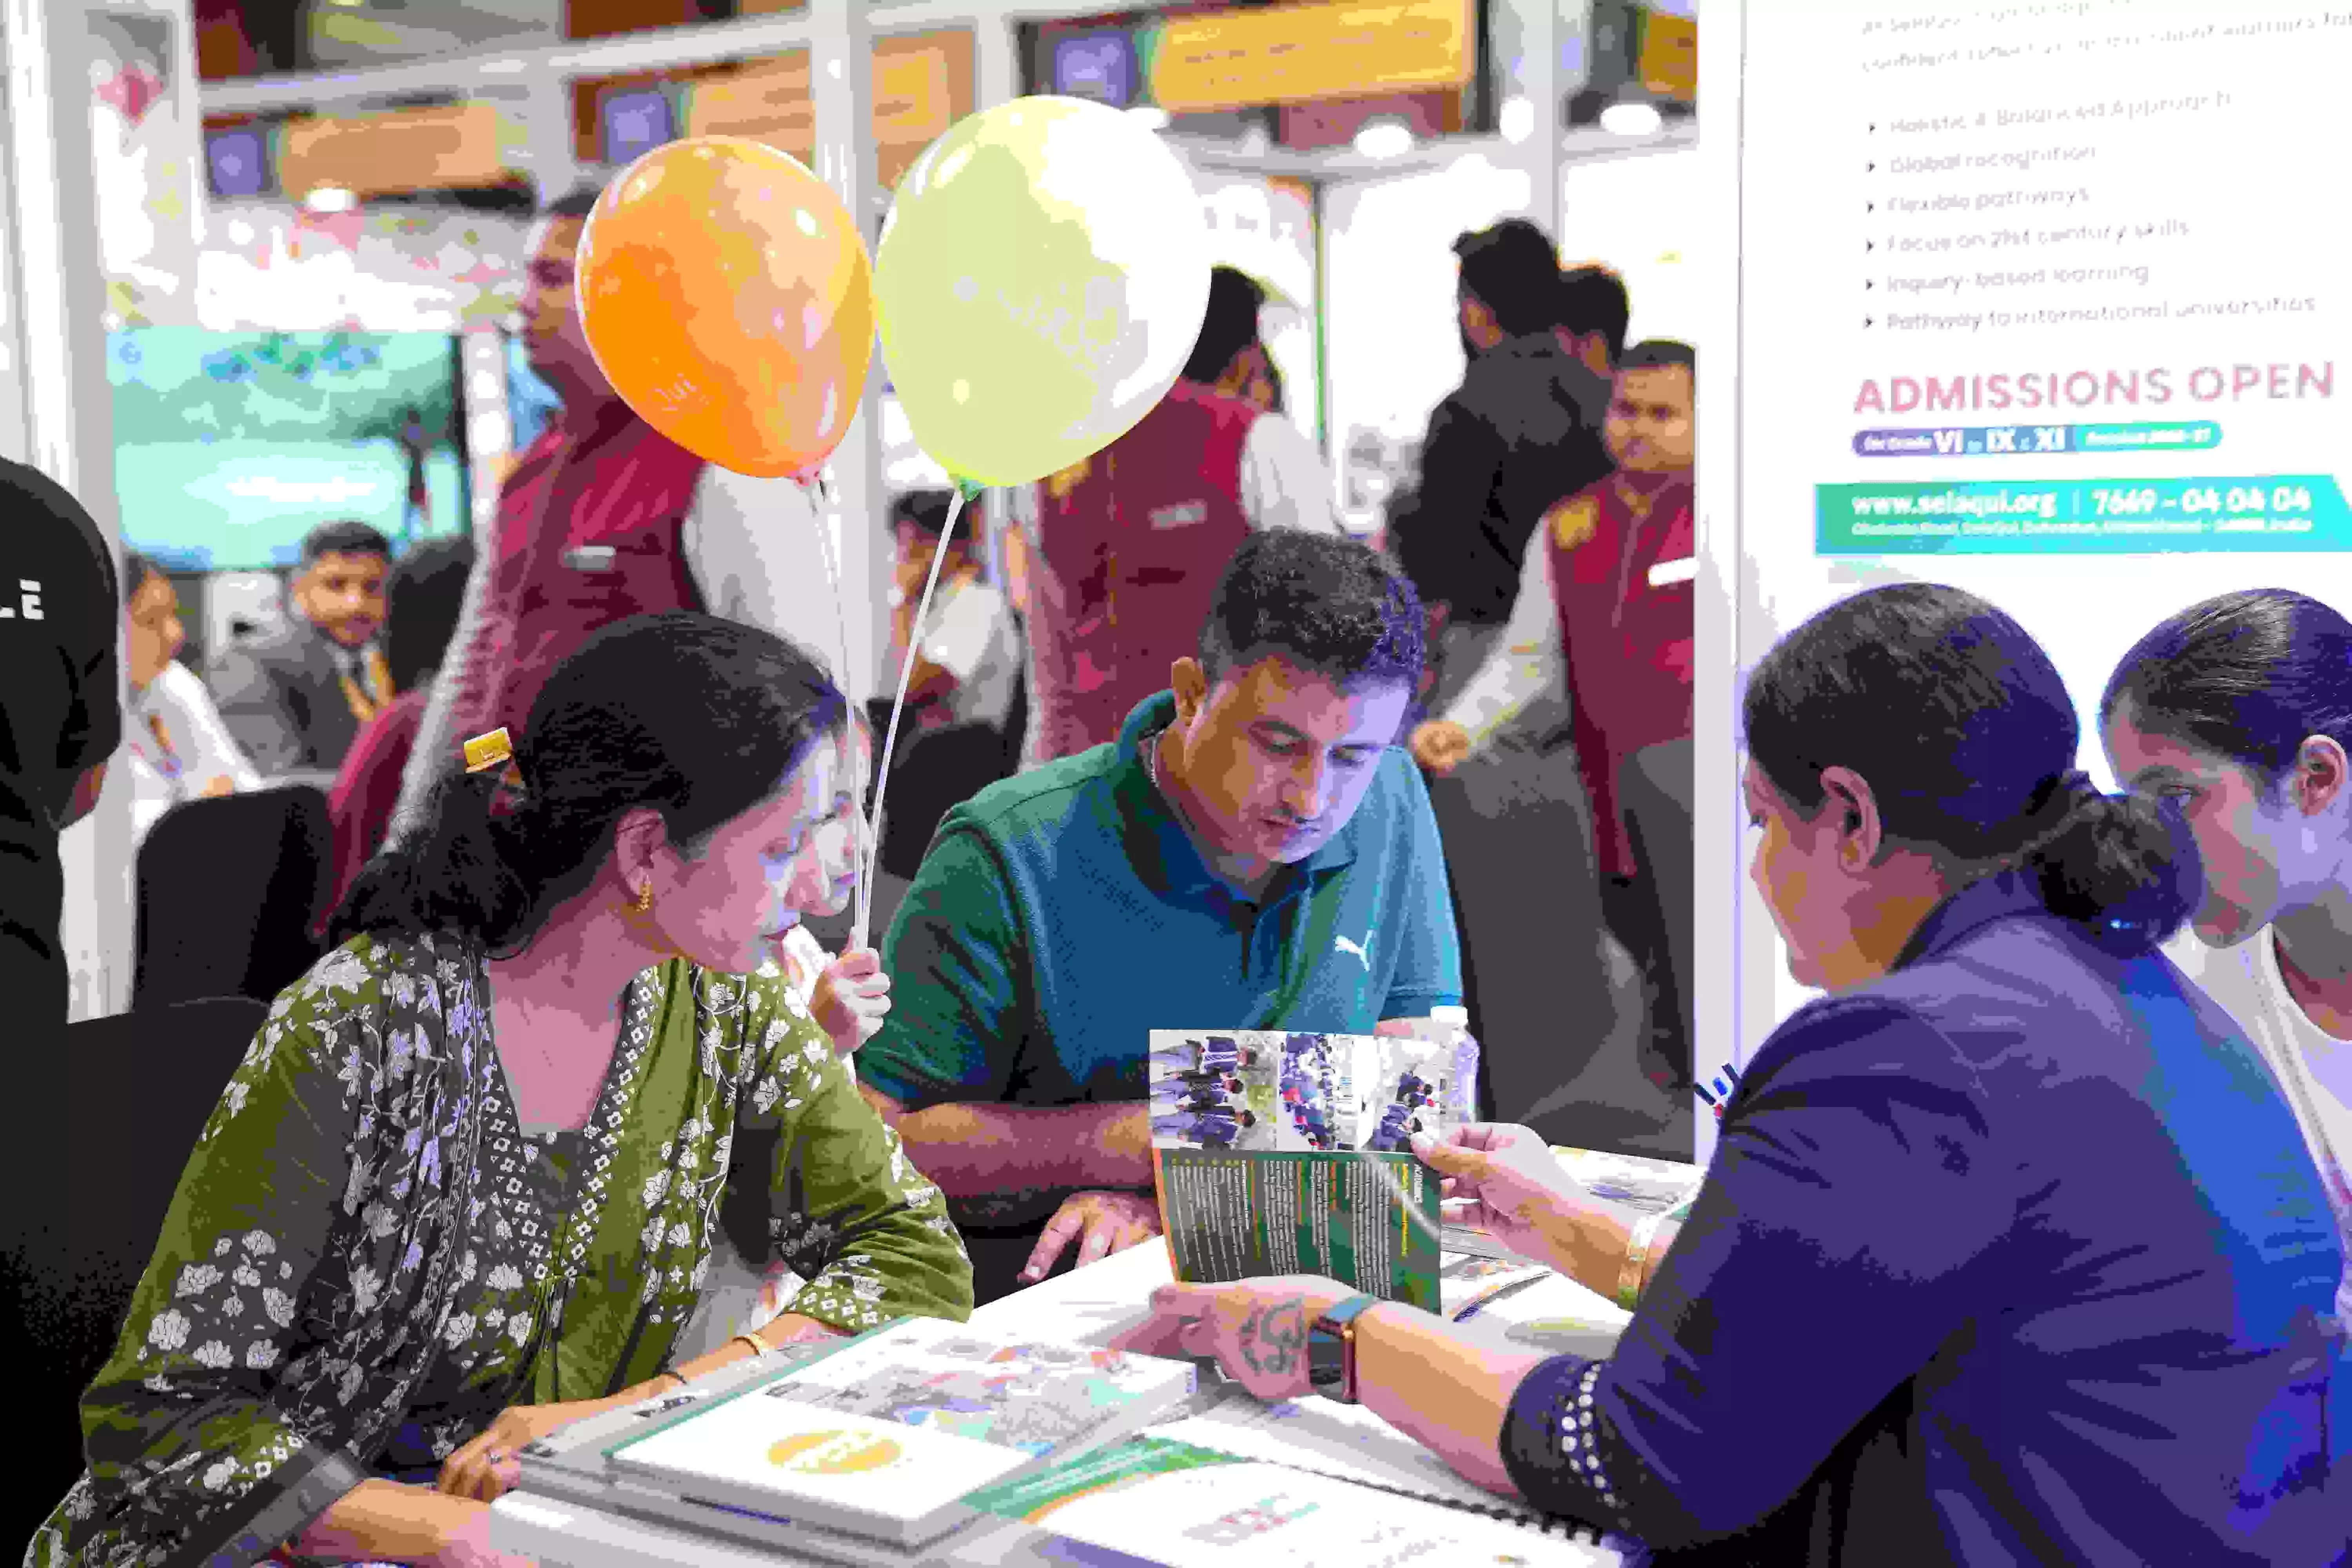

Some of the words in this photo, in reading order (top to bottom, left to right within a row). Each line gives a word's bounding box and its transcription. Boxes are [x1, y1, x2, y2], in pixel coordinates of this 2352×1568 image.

[1891, 153, 1960, 172] Global
[1966, 147, 2096, 170] recognition
[1887, 194, 1970, 213] Flexible
[1975, 187, 2089, 211] pathways
[1887, 234, 1951, 252] Focus
[1956, 234, 1985, 249] on
[2038, 225, 2127, 245] century
[2135, 219, 2190, 239] skills
[2053, 266, 2149, 286] learning
[1887, 313, 1983, 333] Pathway
[1987, 310, 2011, 327] to
[2016, 300, 2168, 325] international
[2176, 297, 2315, 318] universities
[1853, 367, 2174, 415] ADMISSIONS
[2187, 360, 2334, 402] OPEN
[1933, 429, 1963, 454] VI
[1986, 428, 2016, 452] IX
[2033, 426, 2065, 451] XI
[2181, 488, 2221, 513] 04
[2226, 488, 2265, 512] 04
[2272, 486, 2312, 512] 04
